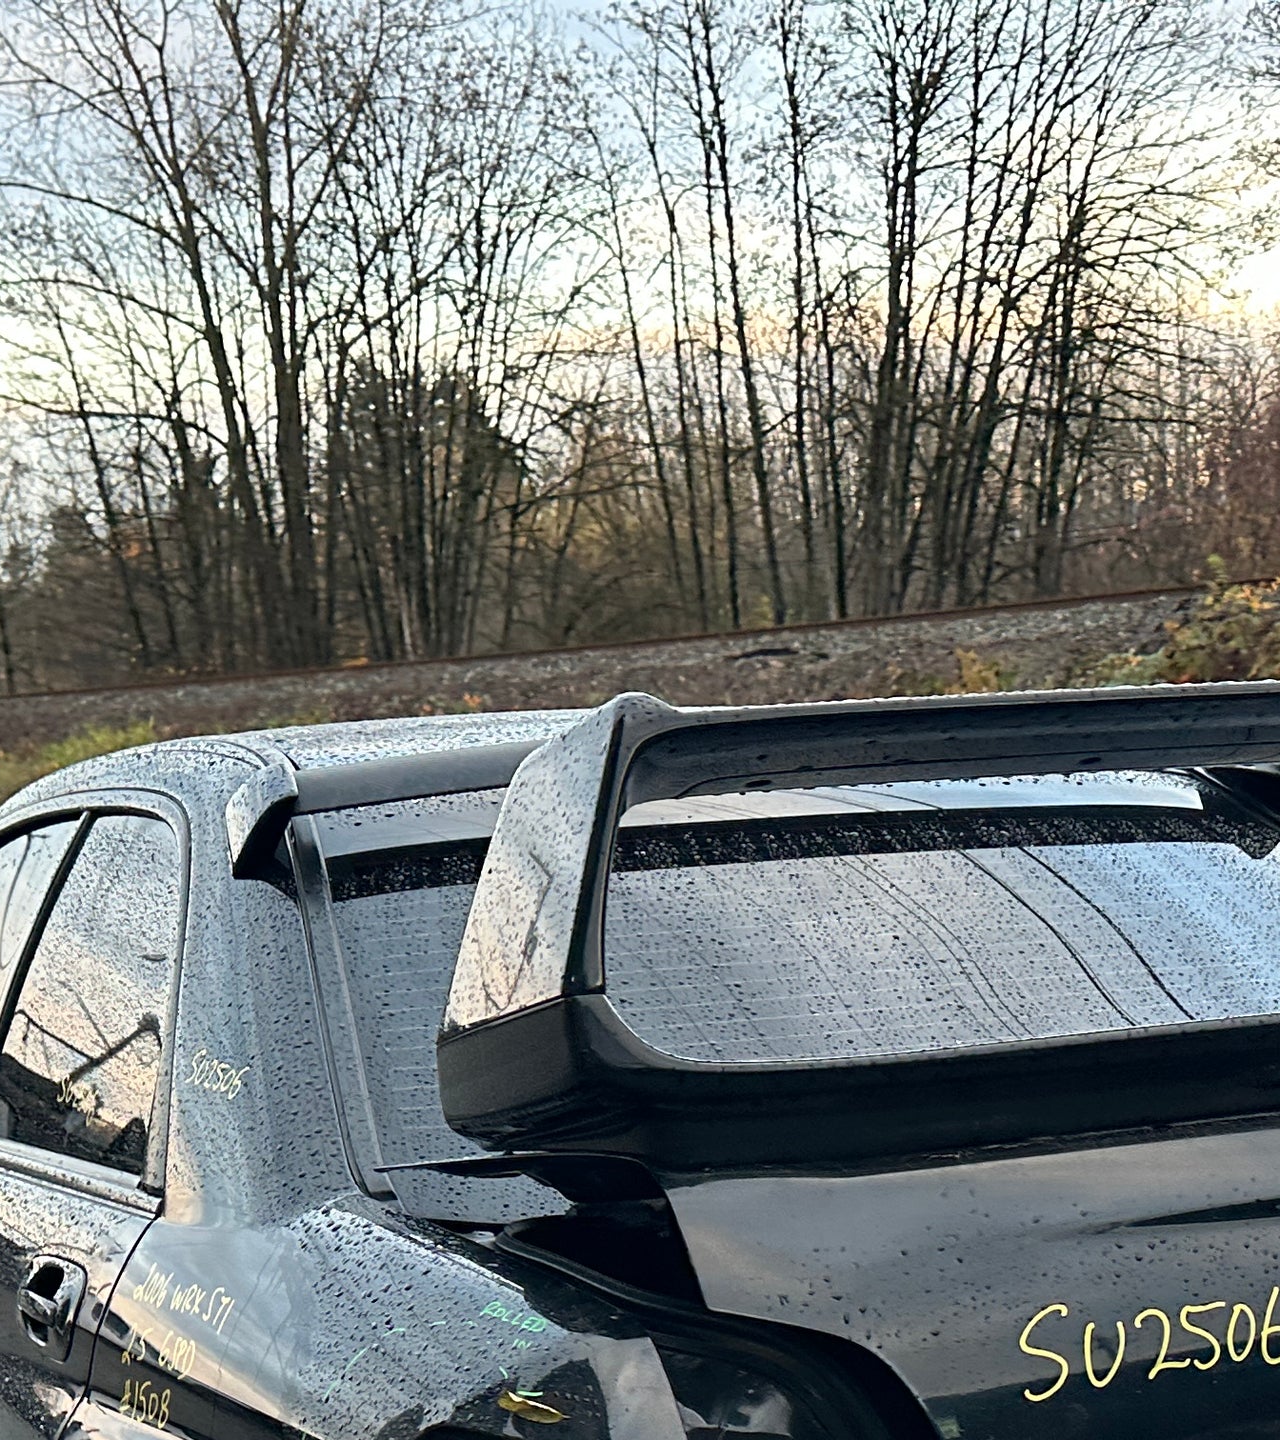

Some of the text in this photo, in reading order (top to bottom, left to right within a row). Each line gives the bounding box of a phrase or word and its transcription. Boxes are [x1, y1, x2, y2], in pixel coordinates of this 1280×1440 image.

[133, 1262, 175, 1309] 2006
[169, 1283, 207, 1316] WRX
[479, 1301, 547, 1332] ROLLED
